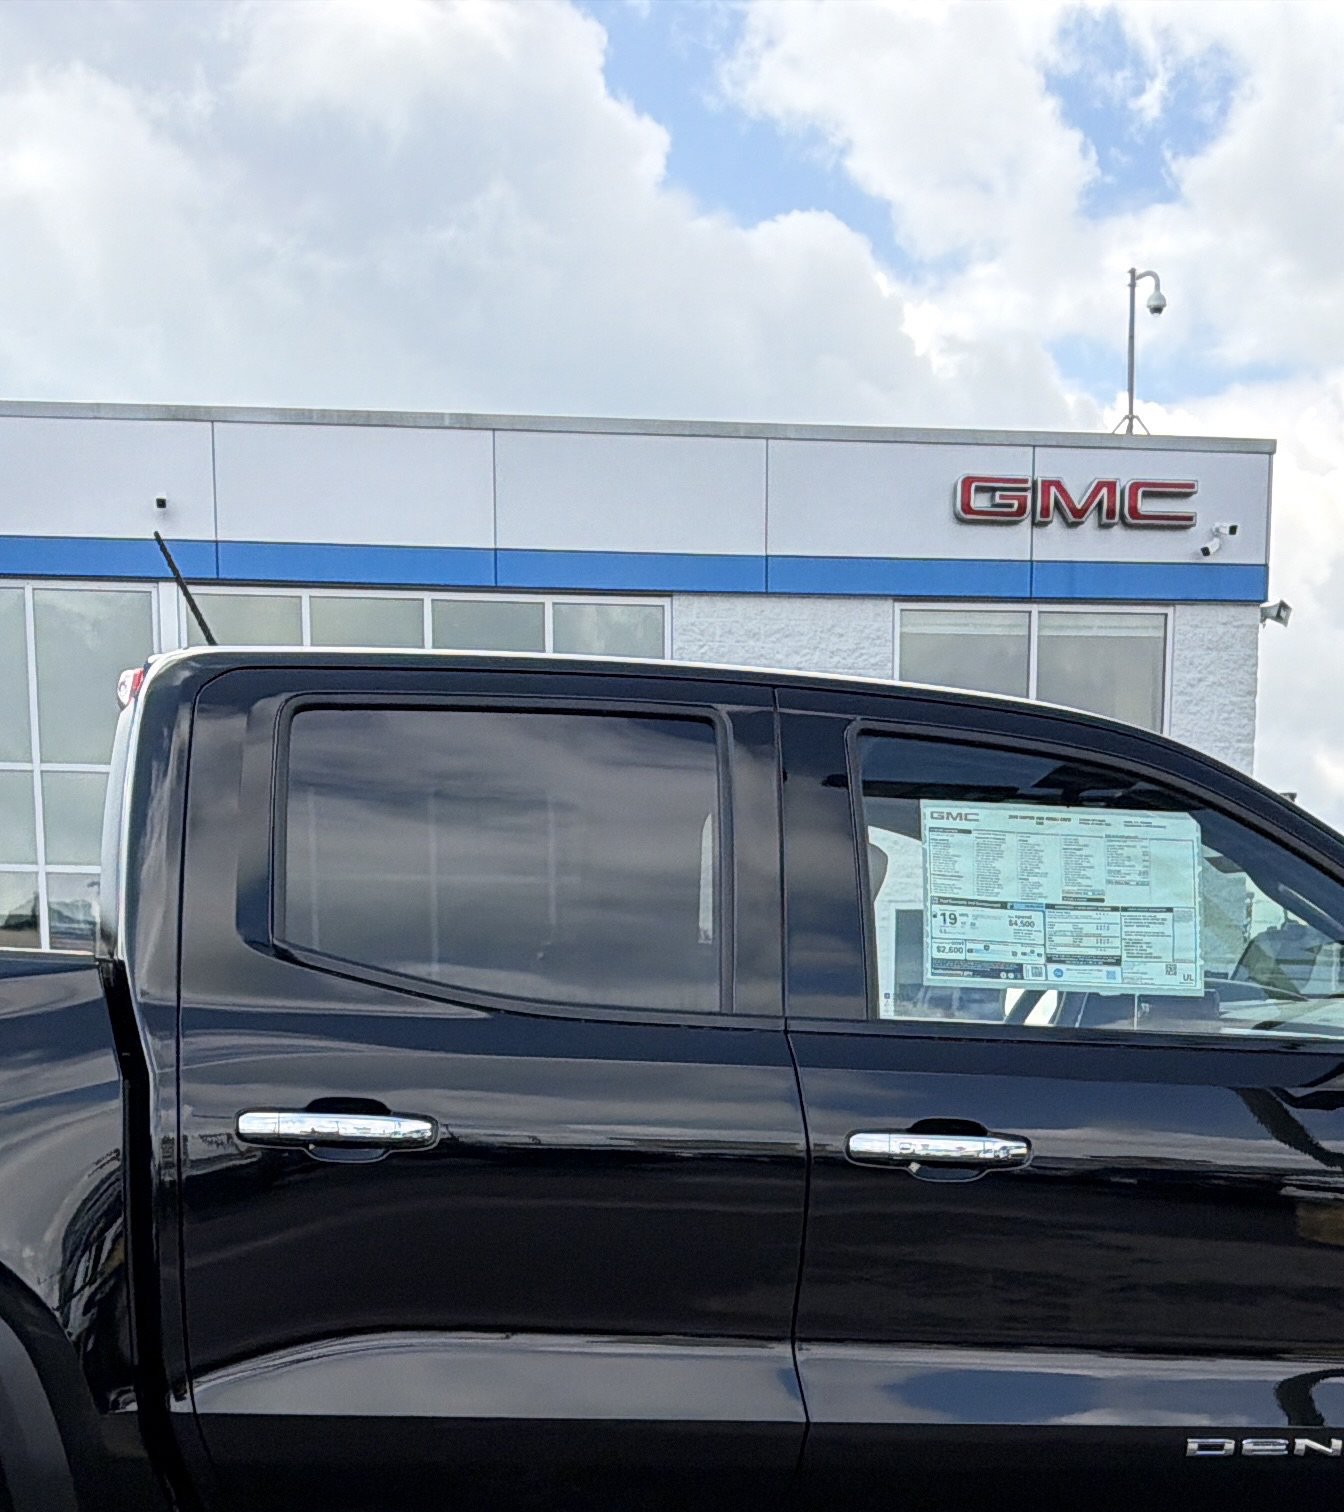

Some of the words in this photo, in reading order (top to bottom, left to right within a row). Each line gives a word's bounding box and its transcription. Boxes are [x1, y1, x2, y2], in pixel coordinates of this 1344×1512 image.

[955, 474, 1198, 528] GMC
[930, 811, 980, 822] GMC
[939, 912, 958, 926] 19
[1182, 973, 1195, 982] UL
